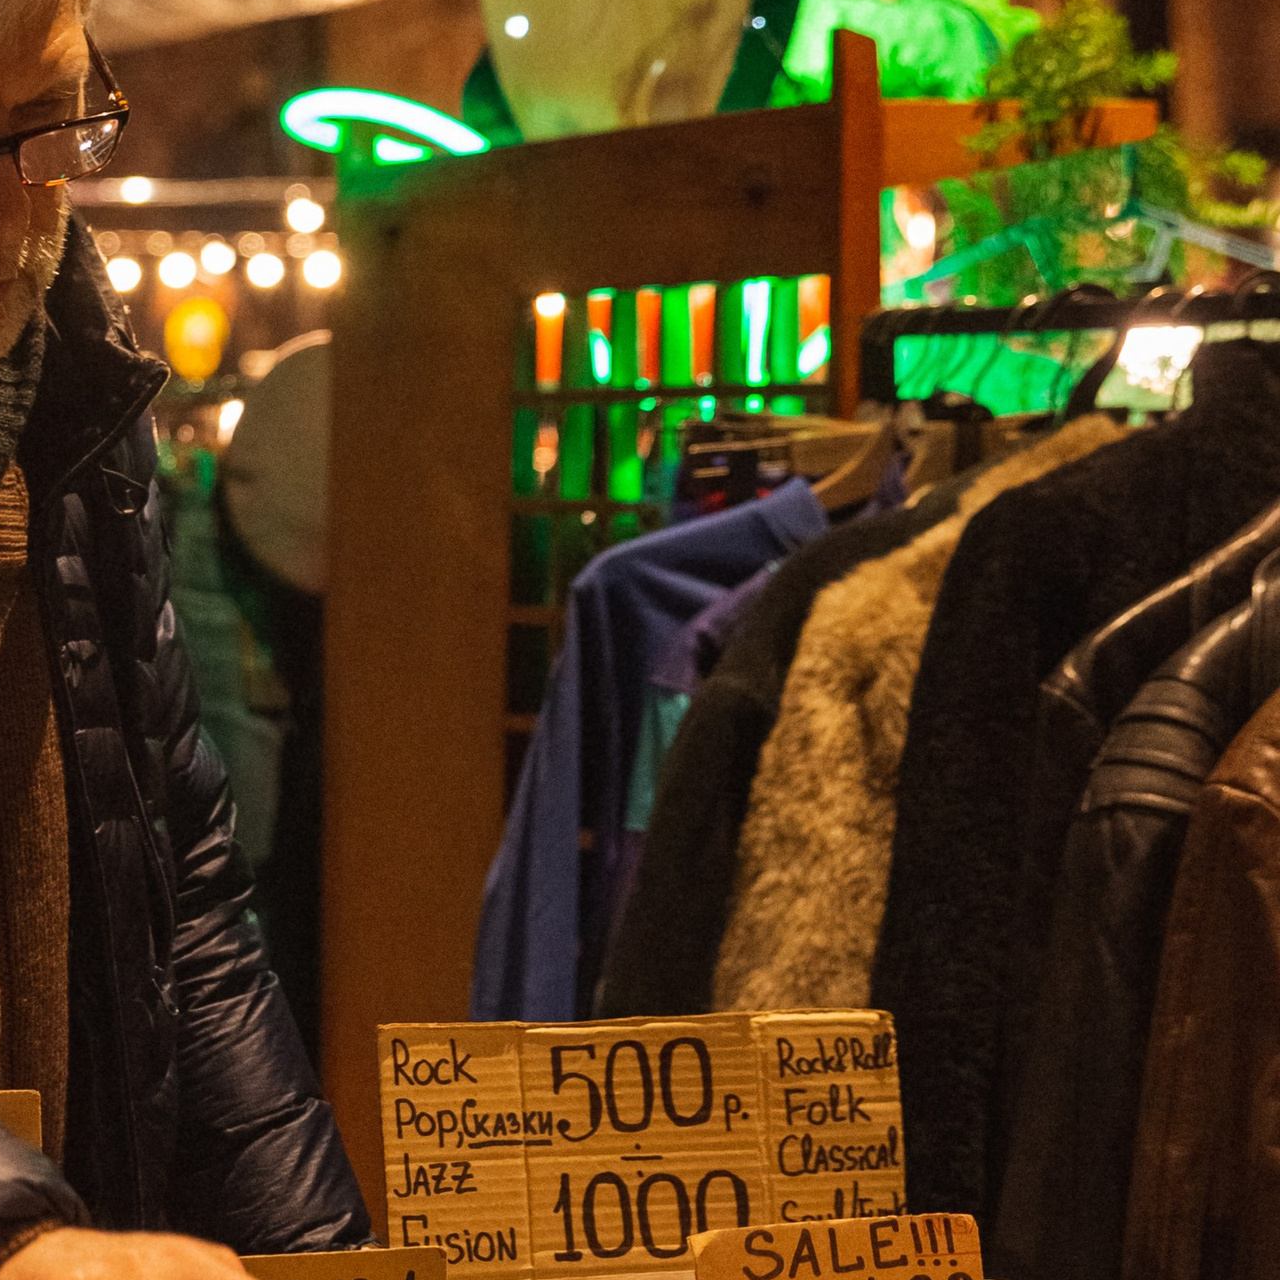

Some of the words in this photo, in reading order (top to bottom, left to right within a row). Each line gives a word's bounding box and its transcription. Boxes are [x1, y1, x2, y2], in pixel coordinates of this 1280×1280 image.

[391, 1037, 478, 1086] Rock
[550, 1036, 715, 1142] 500
[783, 1083, 872, 1126] Folk
[392, 1152, 478, 1198] JAZZ
[551, 1169, 752, 1263] 1000
